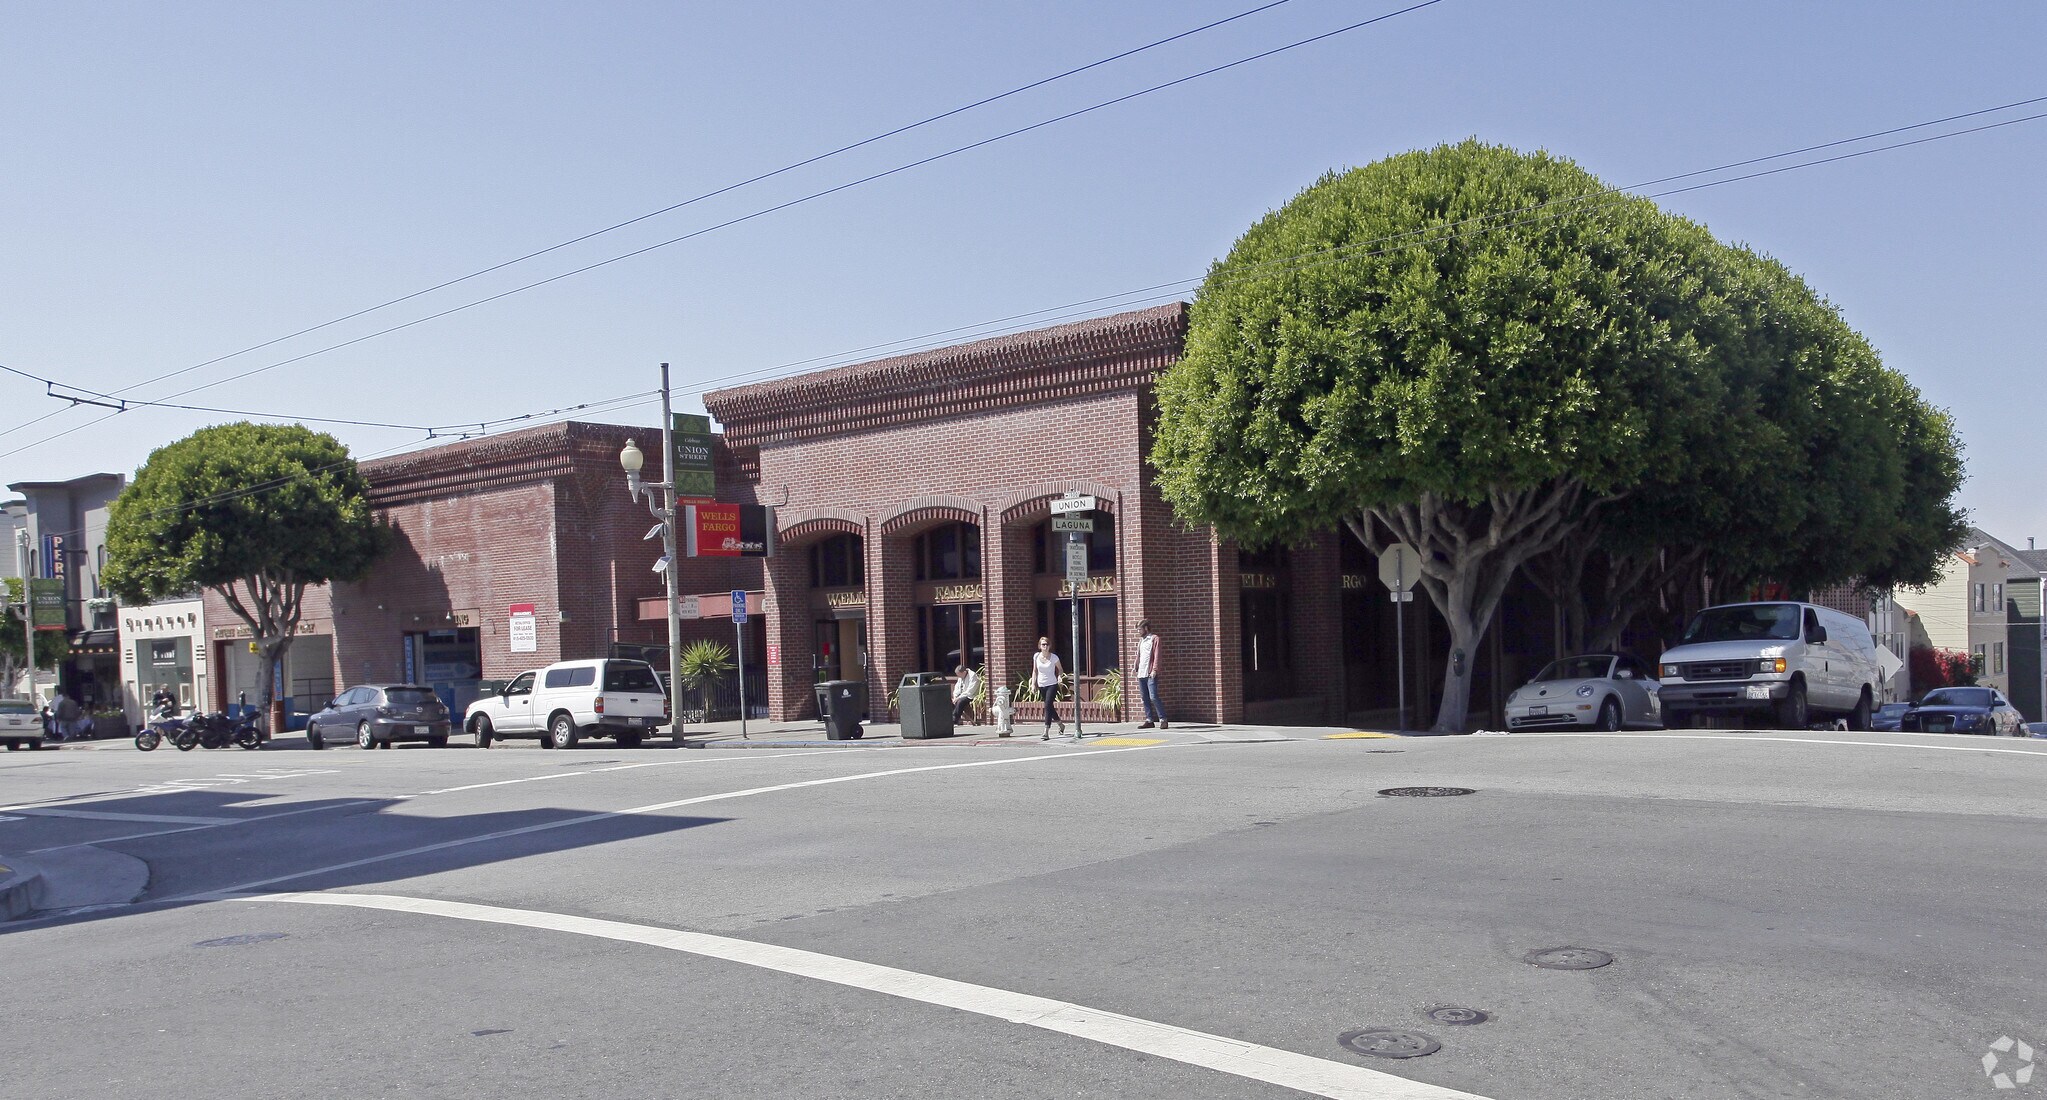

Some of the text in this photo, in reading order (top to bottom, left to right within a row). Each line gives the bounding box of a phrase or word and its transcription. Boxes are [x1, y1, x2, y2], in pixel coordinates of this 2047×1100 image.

[677, 445, 709, 455] UNION
[1058, 499, 1086, 510] UNION
[701, 512, 736, 521] WELLS
[702, 522, 736, 532] FARGO
[1055, 521, 1090, 530] LAGUNA
[53, 536, 64, 580] PER
[1061, 576, 1113, 592] BANK
[1240, 573, 1367, 589] ELLS RGO
[826, 591, 866, 606] WELL
